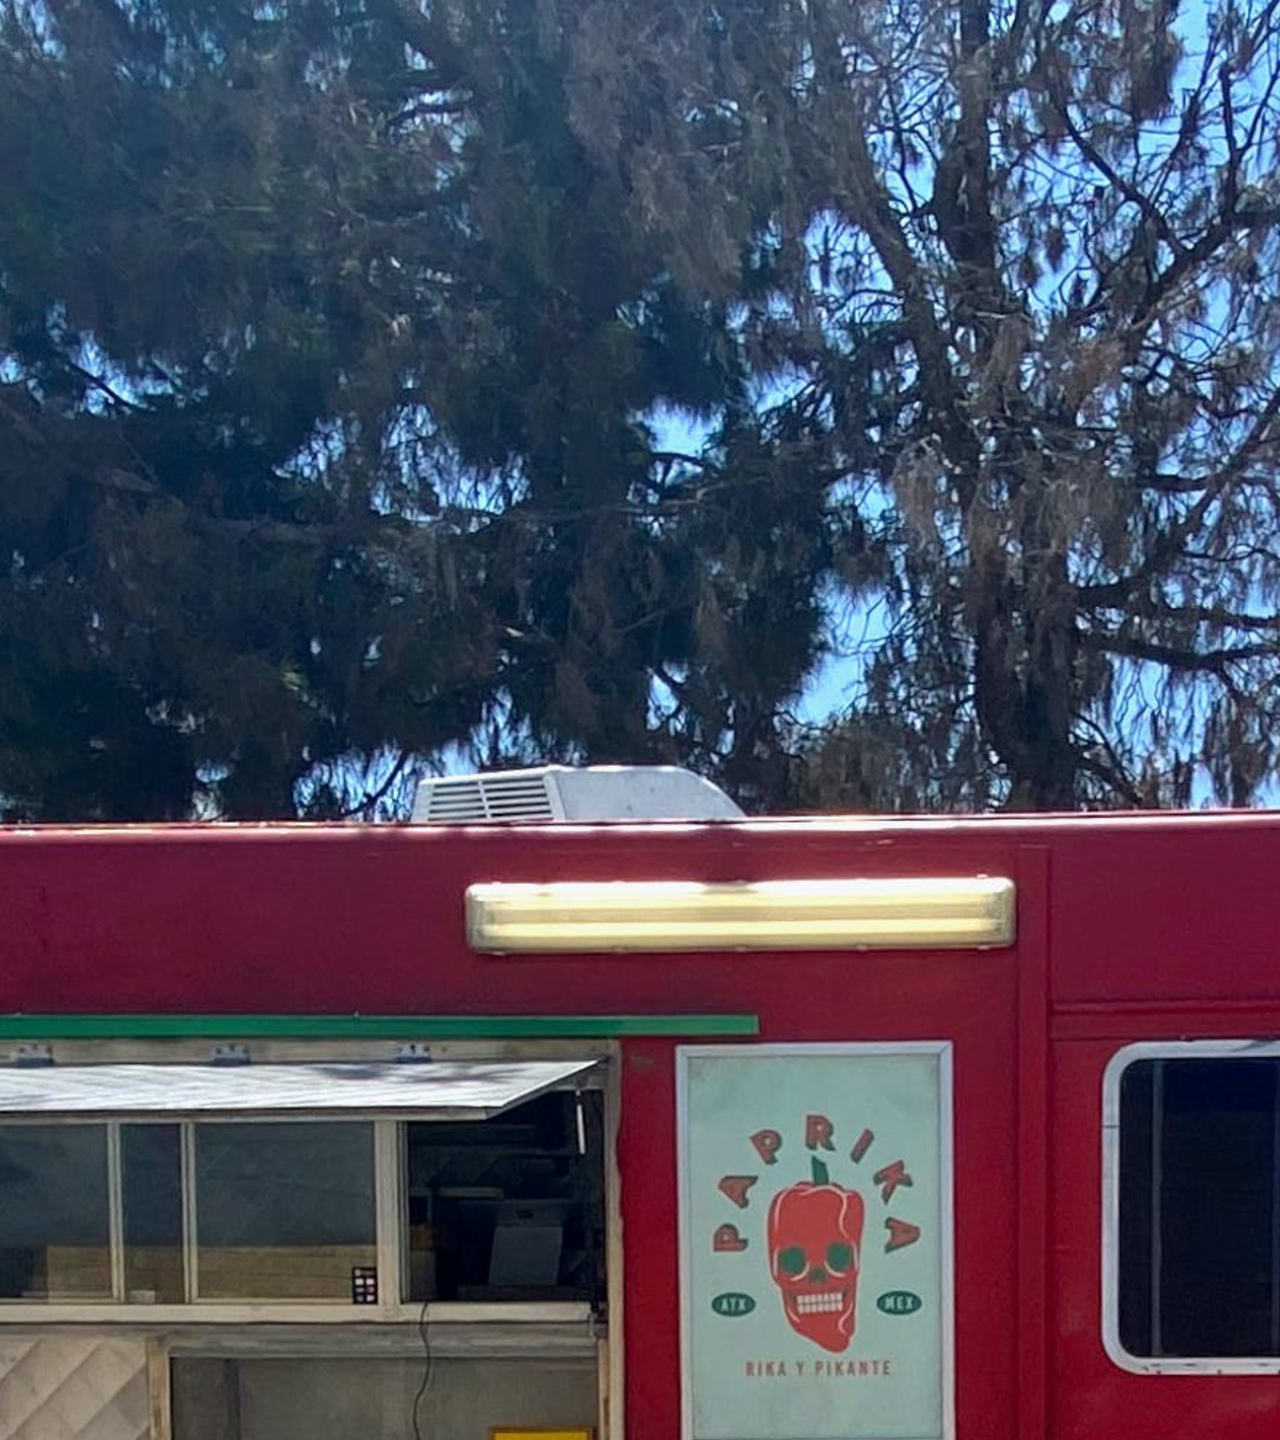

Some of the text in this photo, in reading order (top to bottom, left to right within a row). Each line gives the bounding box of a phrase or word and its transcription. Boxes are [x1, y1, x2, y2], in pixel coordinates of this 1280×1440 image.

[713, 1114, 921, 1253] PAPRIKA
[885, 1295, 914, 1310] MEX
[745, 1360, 891, 1377] RIKA Y PIKANTE
